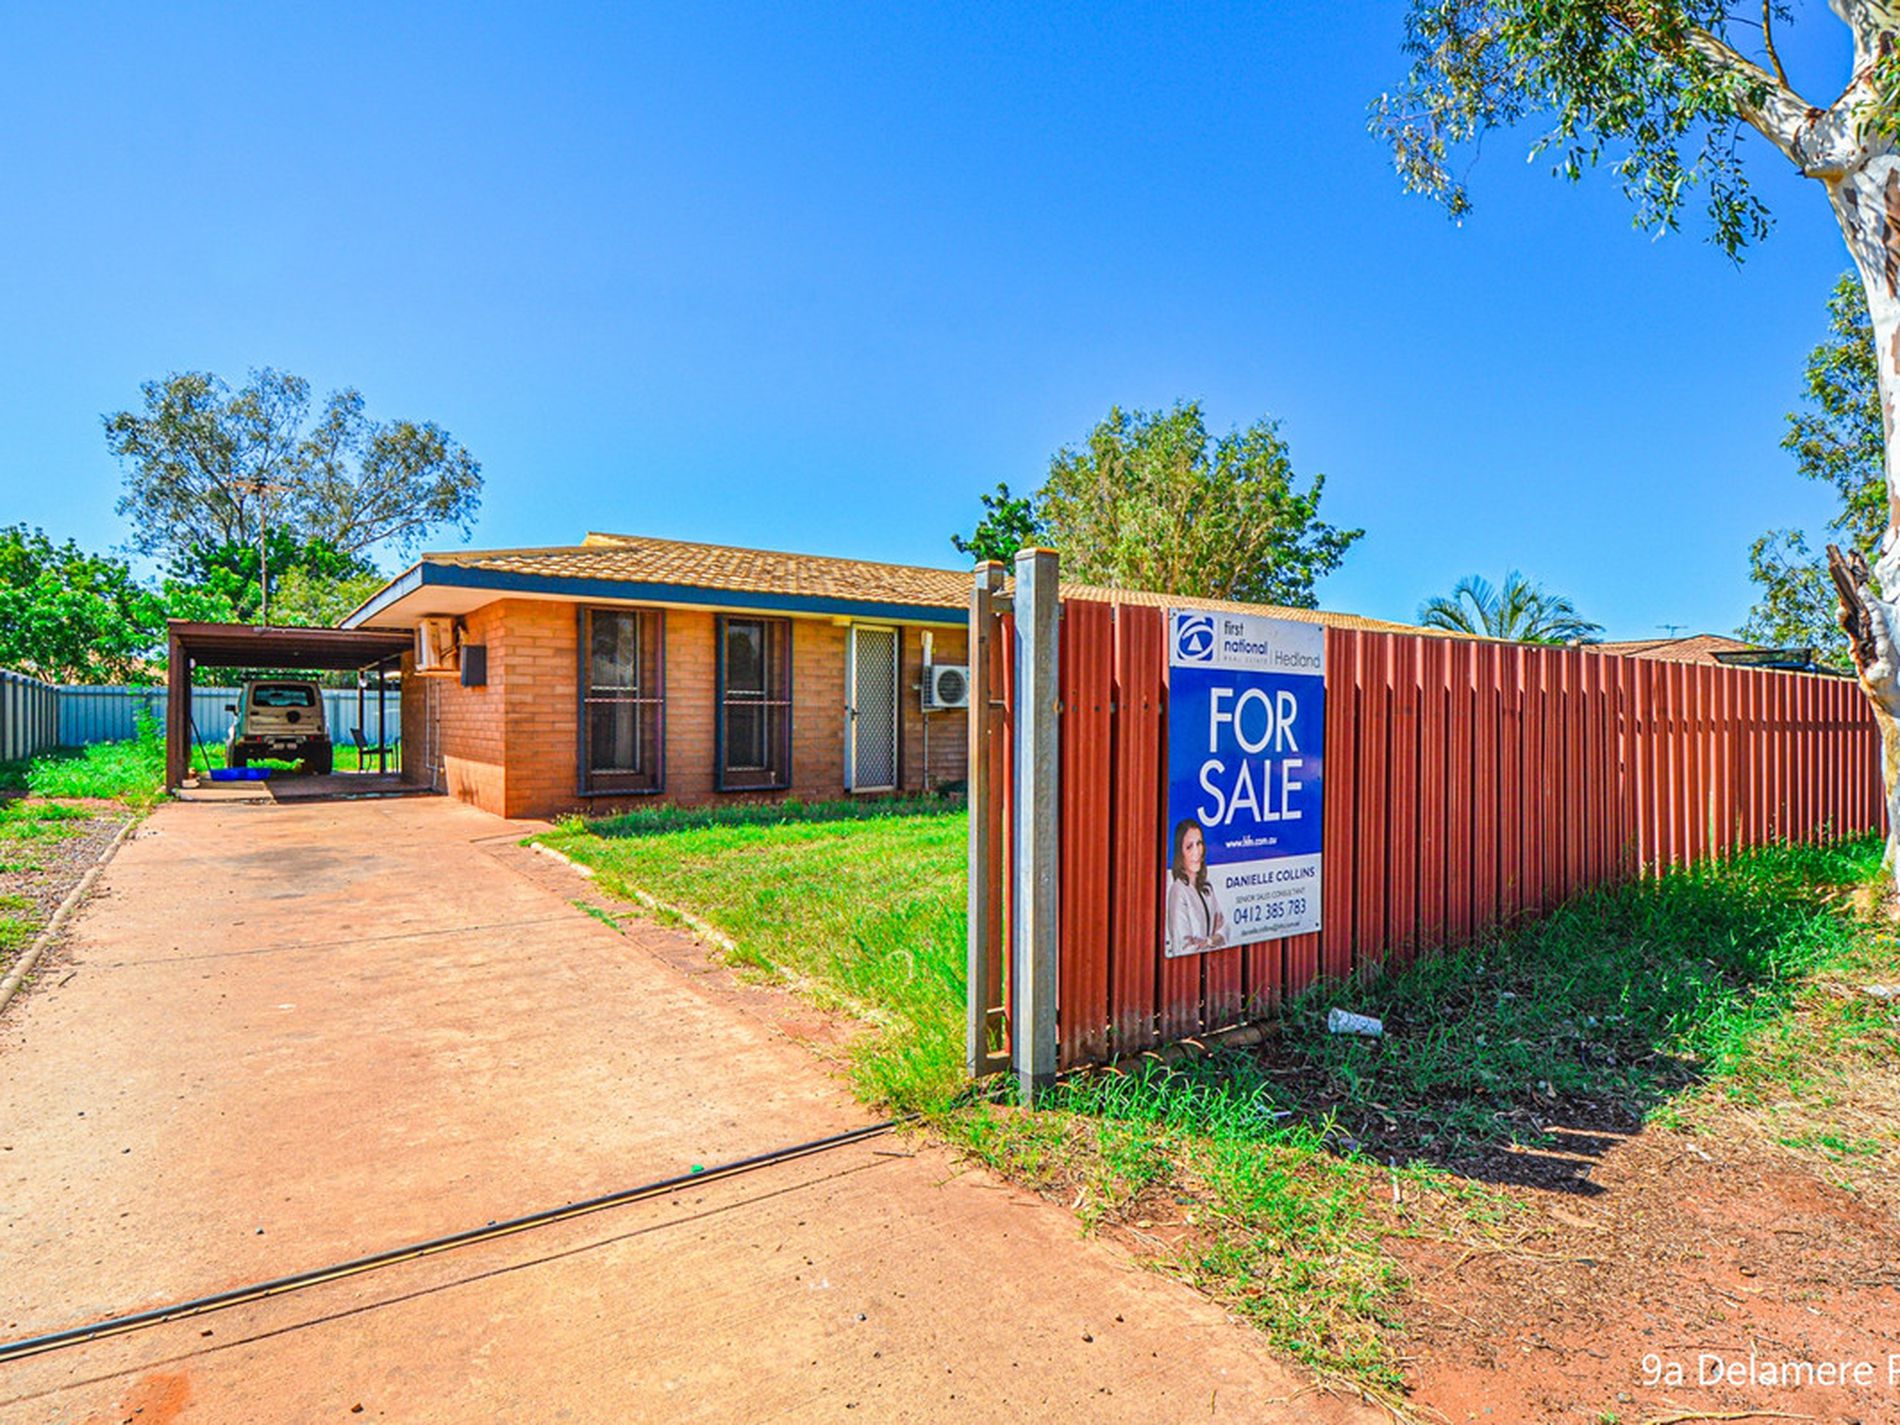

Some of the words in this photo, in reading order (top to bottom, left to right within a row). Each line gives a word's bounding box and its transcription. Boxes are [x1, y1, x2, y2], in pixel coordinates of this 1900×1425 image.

[1224, 620, 1245, 636] first
[1224, 639, 1268, 655] national
[1275, 651, 1321, 668] Hedland
[1210, 687, 1299, 754] FOR
[1197, 758, 1303, 828] SALE
[1226, 871, 1274, 889] DANIELLE
[1276, 866, 1315, 882] COLLINS
[1233, 904, 1262, 925] 0412
[1265, 901, 1285, 920] 385
[1288, 897, 1306, 915] 783
